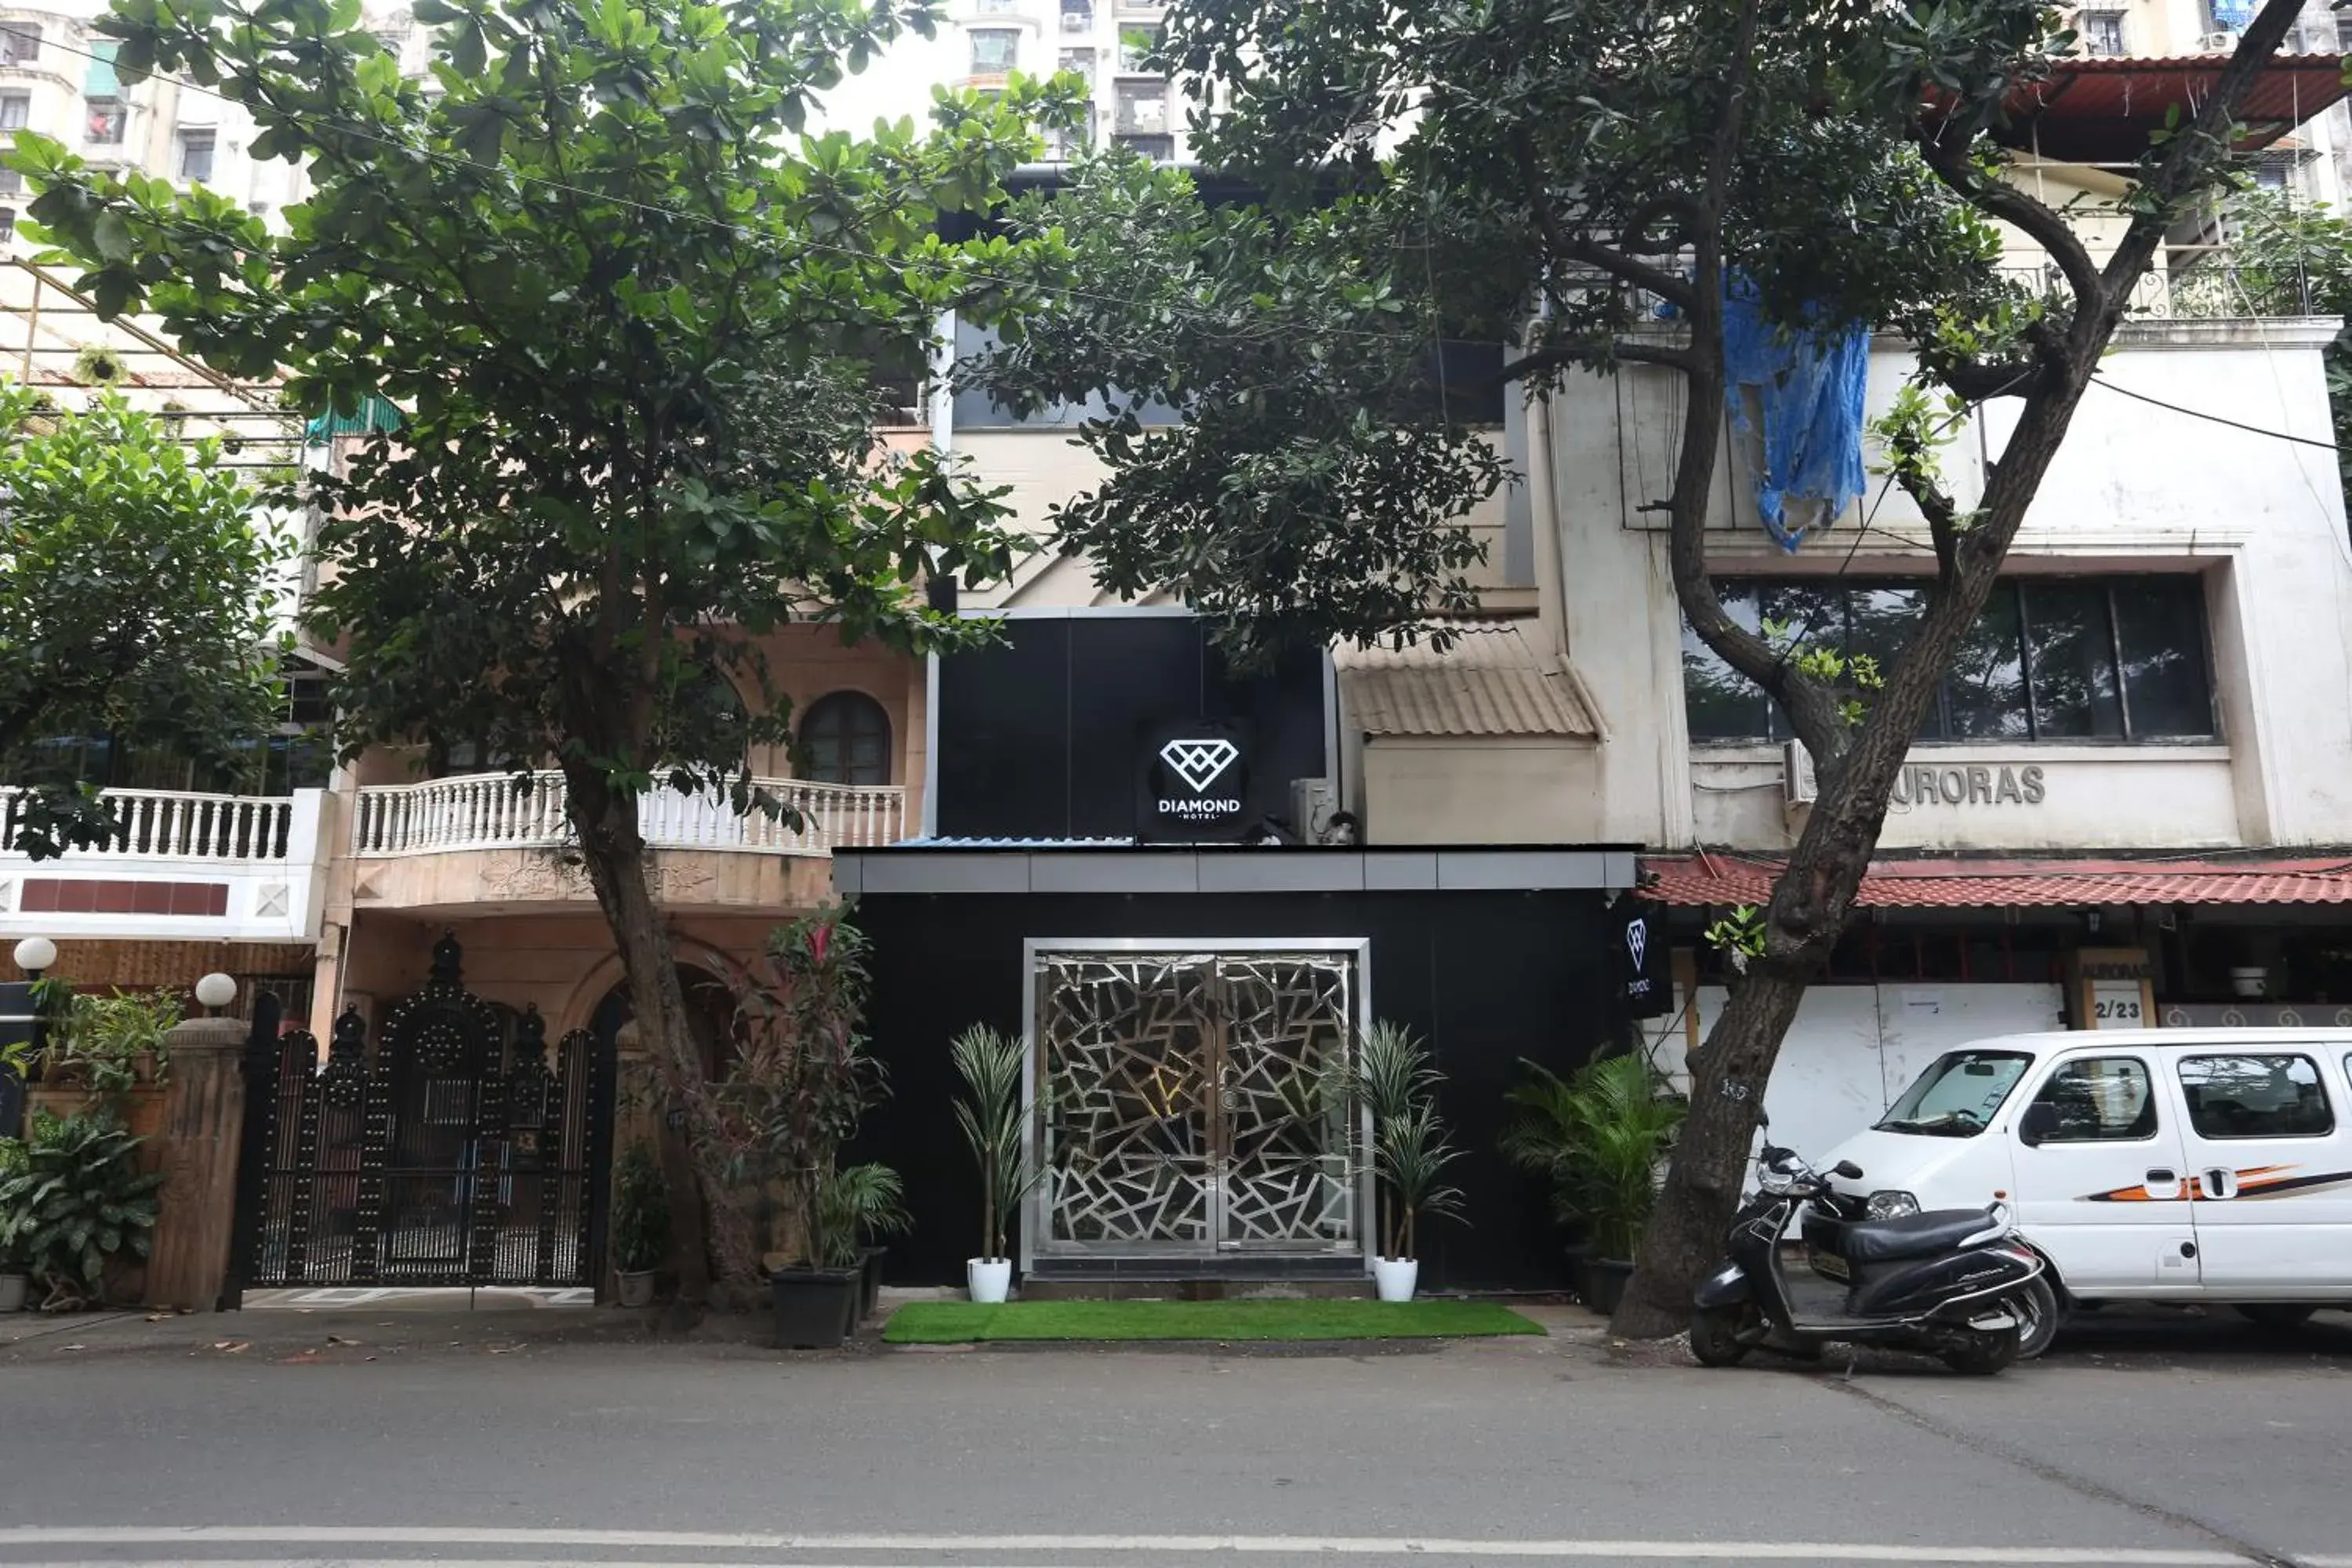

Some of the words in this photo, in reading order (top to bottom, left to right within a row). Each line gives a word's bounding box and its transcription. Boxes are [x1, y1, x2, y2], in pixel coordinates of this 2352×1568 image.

[1889, 765, 2045, 805] URORAS
[1158, 799, 1241, 813] DIAMOND
[2096, 1000, 2140, 1018] 2/23
